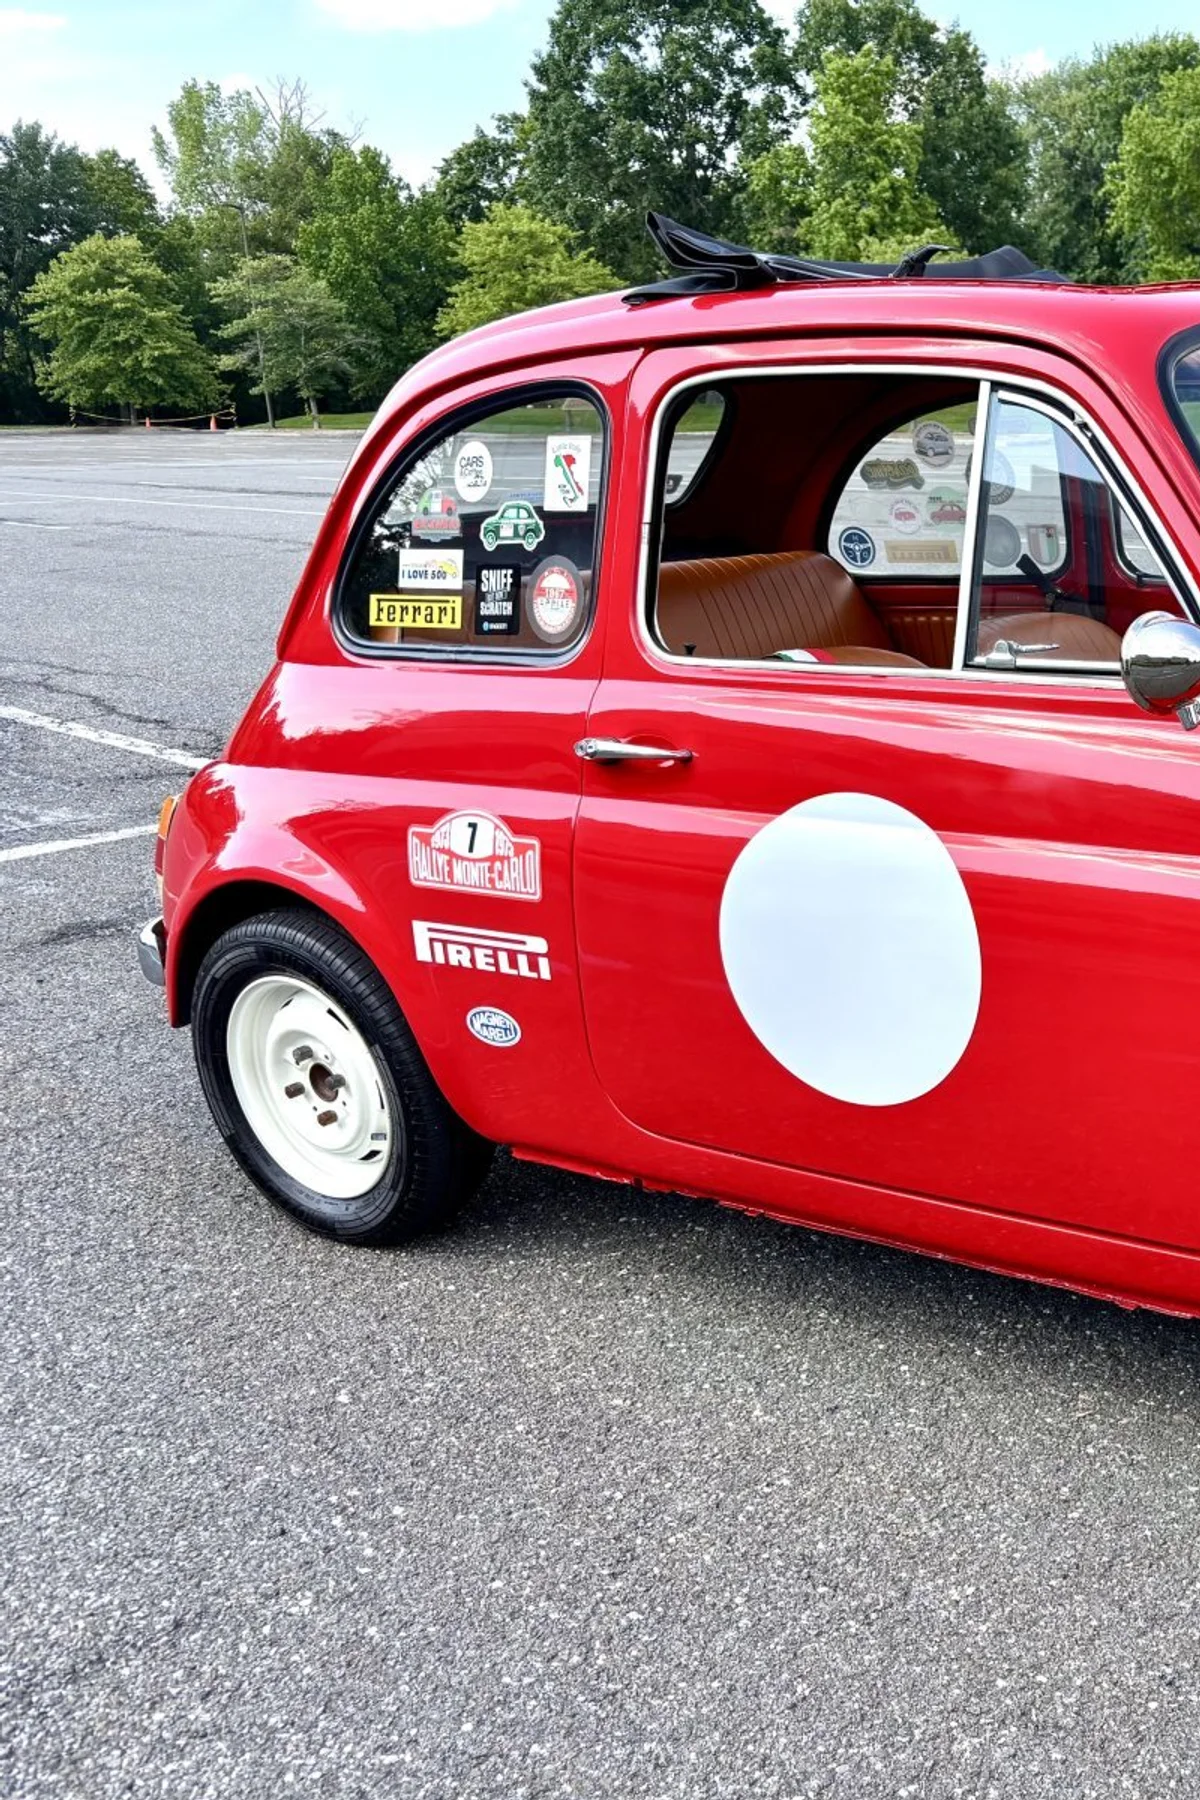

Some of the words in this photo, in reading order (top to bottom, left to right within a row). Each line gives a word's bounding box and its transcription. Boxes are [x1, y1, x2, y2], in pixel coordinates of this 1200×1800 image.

[459, 455, 485, 469] CARS
[407, 569, 429, 580] LOVE
[430, 569, 447, 581] 500
[481, 568, 513, 592] SNIFF
[375, 598, 457, 624] Ferrari
[480, 601, 513, 616] SCRATCH
[467, 822, 478, 853] 7
[412, 835, 451, 883] RALLYE
[452, 850, 536, 893] MONTE-CARLO
[411, 920, 552, 981] PIRELLI
